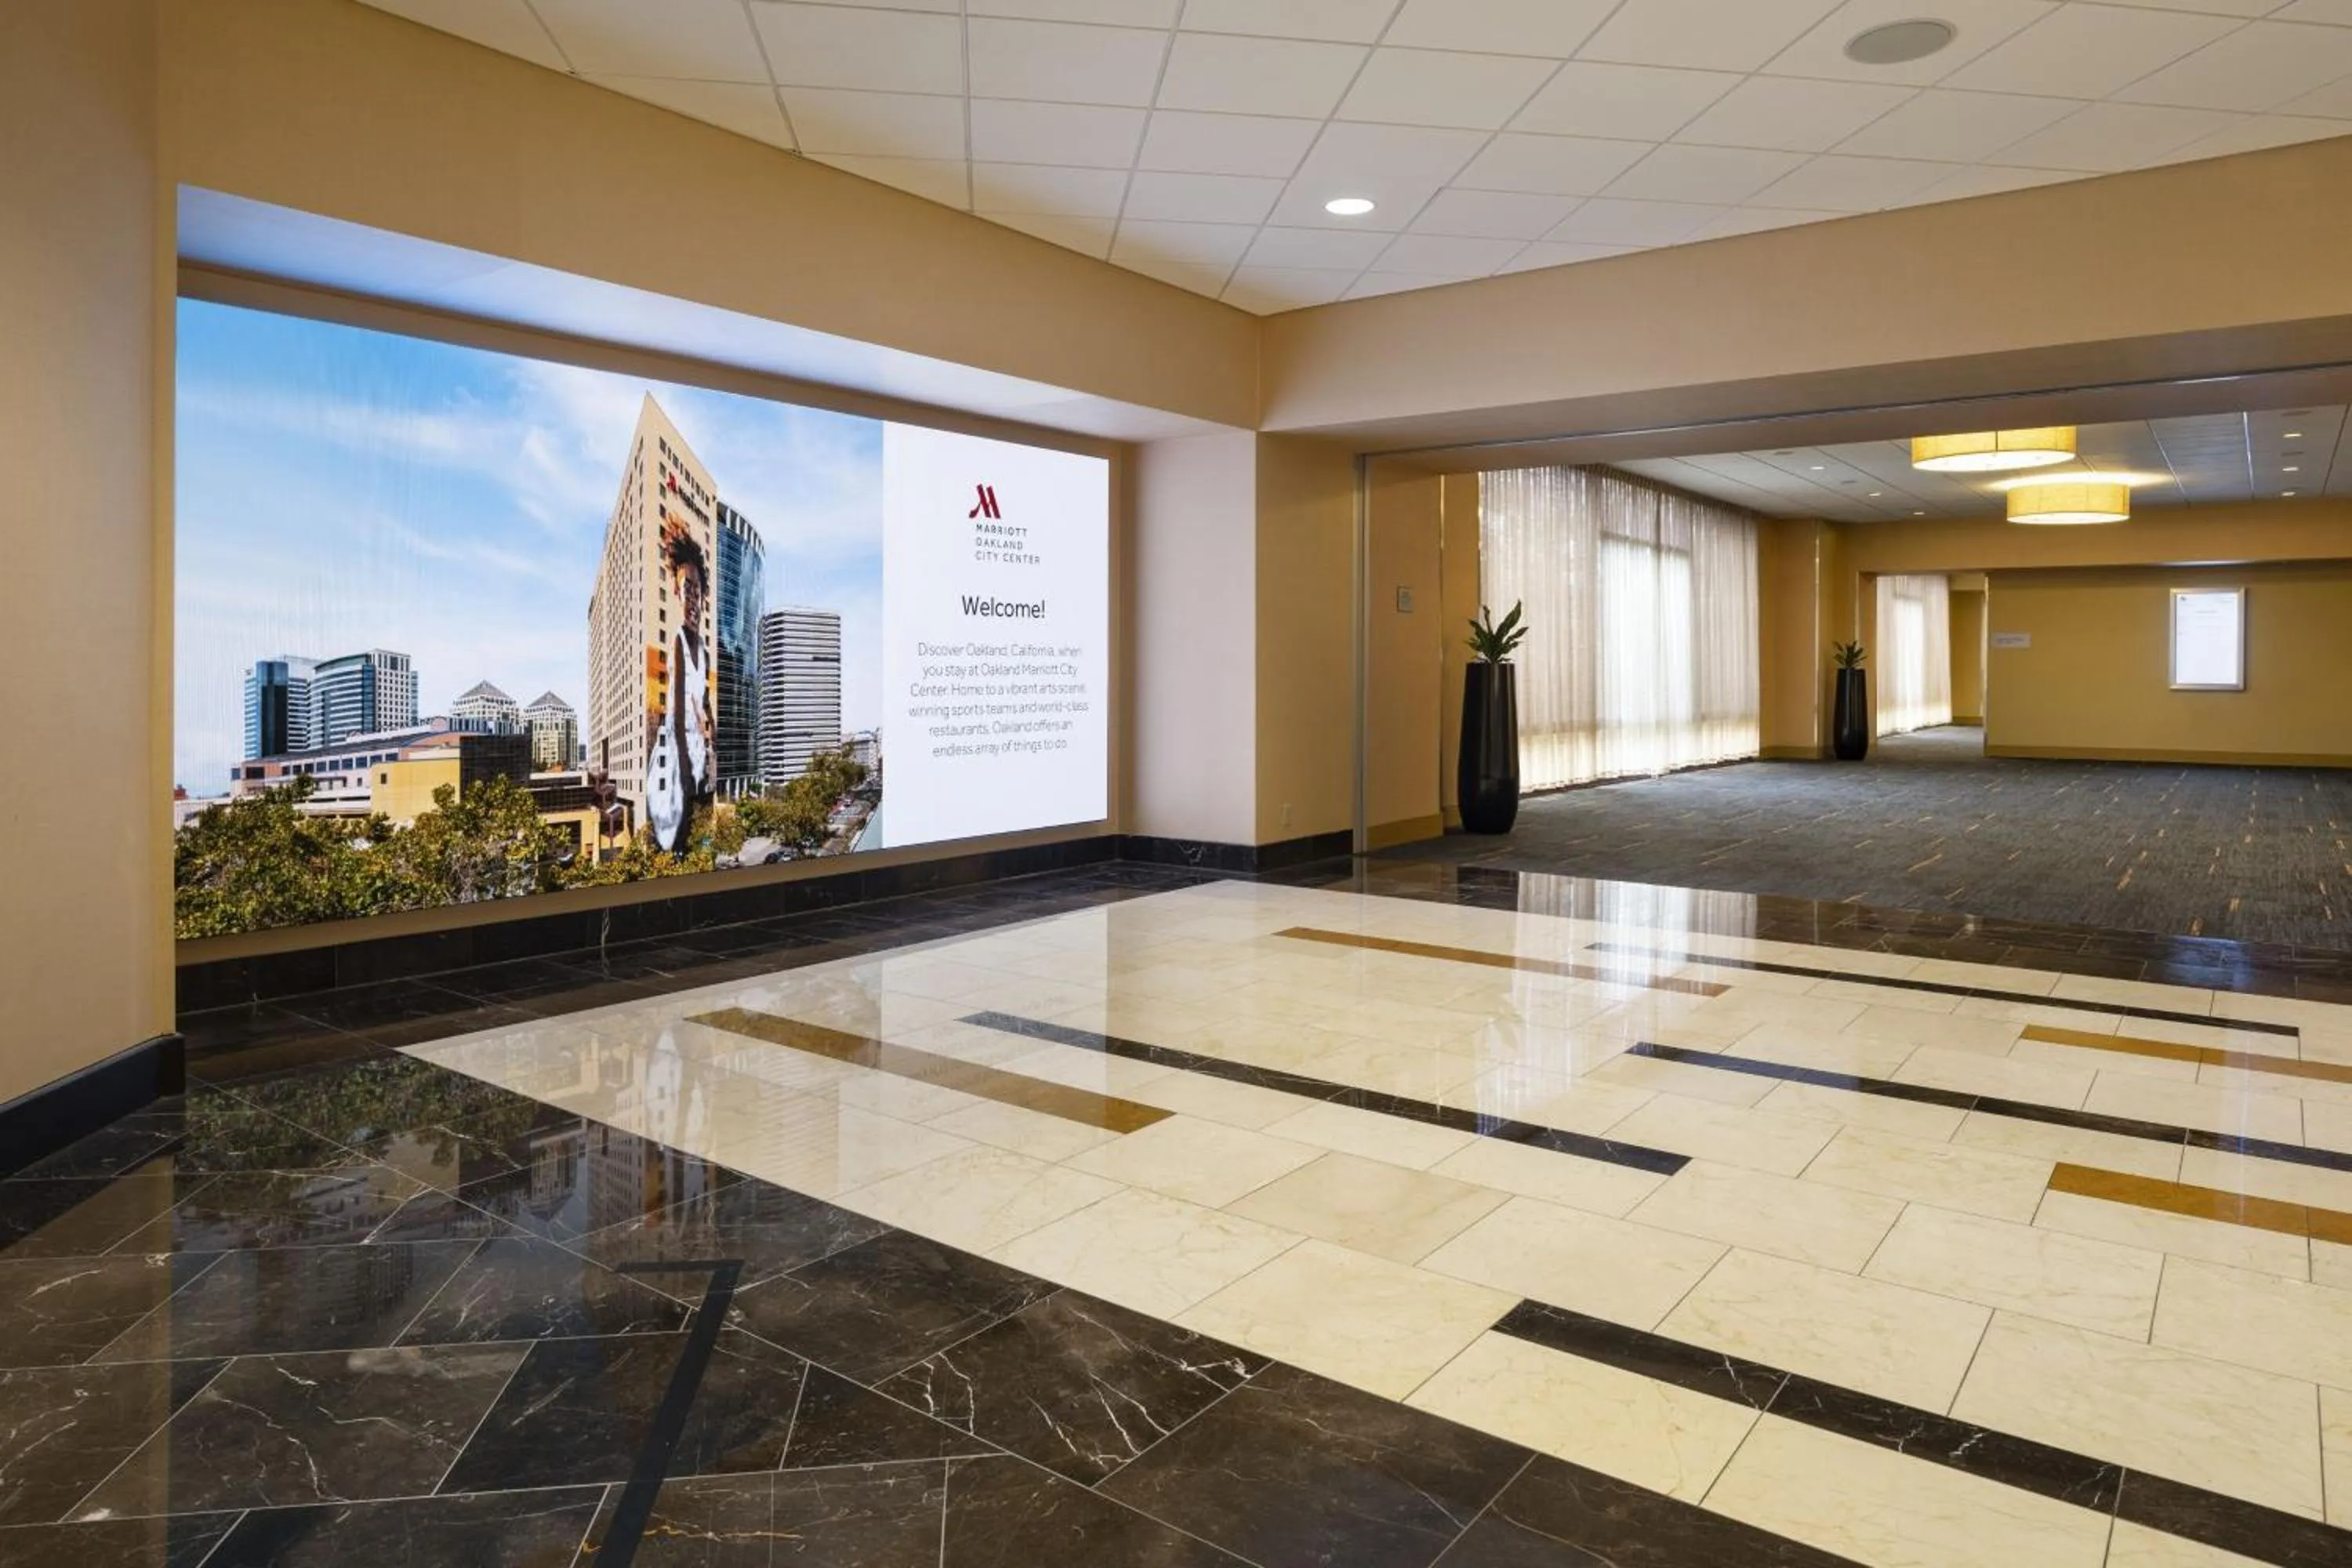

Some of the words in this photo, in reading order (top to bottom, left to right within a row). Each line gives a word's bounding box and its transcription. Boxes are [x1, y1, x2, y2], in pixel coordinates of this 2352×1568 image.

[975, 524, 1027, 537] MARRIOTT
[975, 536, 1023, 550] OAKLAND
[975, 550, 999, 561] CITY
[1004, 553, 1040, 564] CENTER
[962, 595, 1046, 619] Welcome!
[918, 642, 964, 656] Discover
[923, 665, 943, 680] you
[945, 664, 967, 680] stay
[968, 664, 978, 676] at
[981, 662, 1020, 676] Oakland
[1022, 663, 1058, 676] Marriott
[1060, 662, 1078, 678] City
[951, 682, 984, 695] Home
[985, 684, 996, 695] to
[996, 685, 1004, 695] a
[909, 705, 950, 720] winning
[951, 705, 985, 719] sports
[1019, 701, 1036, 713] and
[992, 720, 1033, 734] Oakland
[932, 743, 974, 757] endless
[975, 743, 999, 757] array
[1002, 739, 1013, 753] of
[1013, 739, 1042, 753] things
[1044, 739, 1054, 750] to
